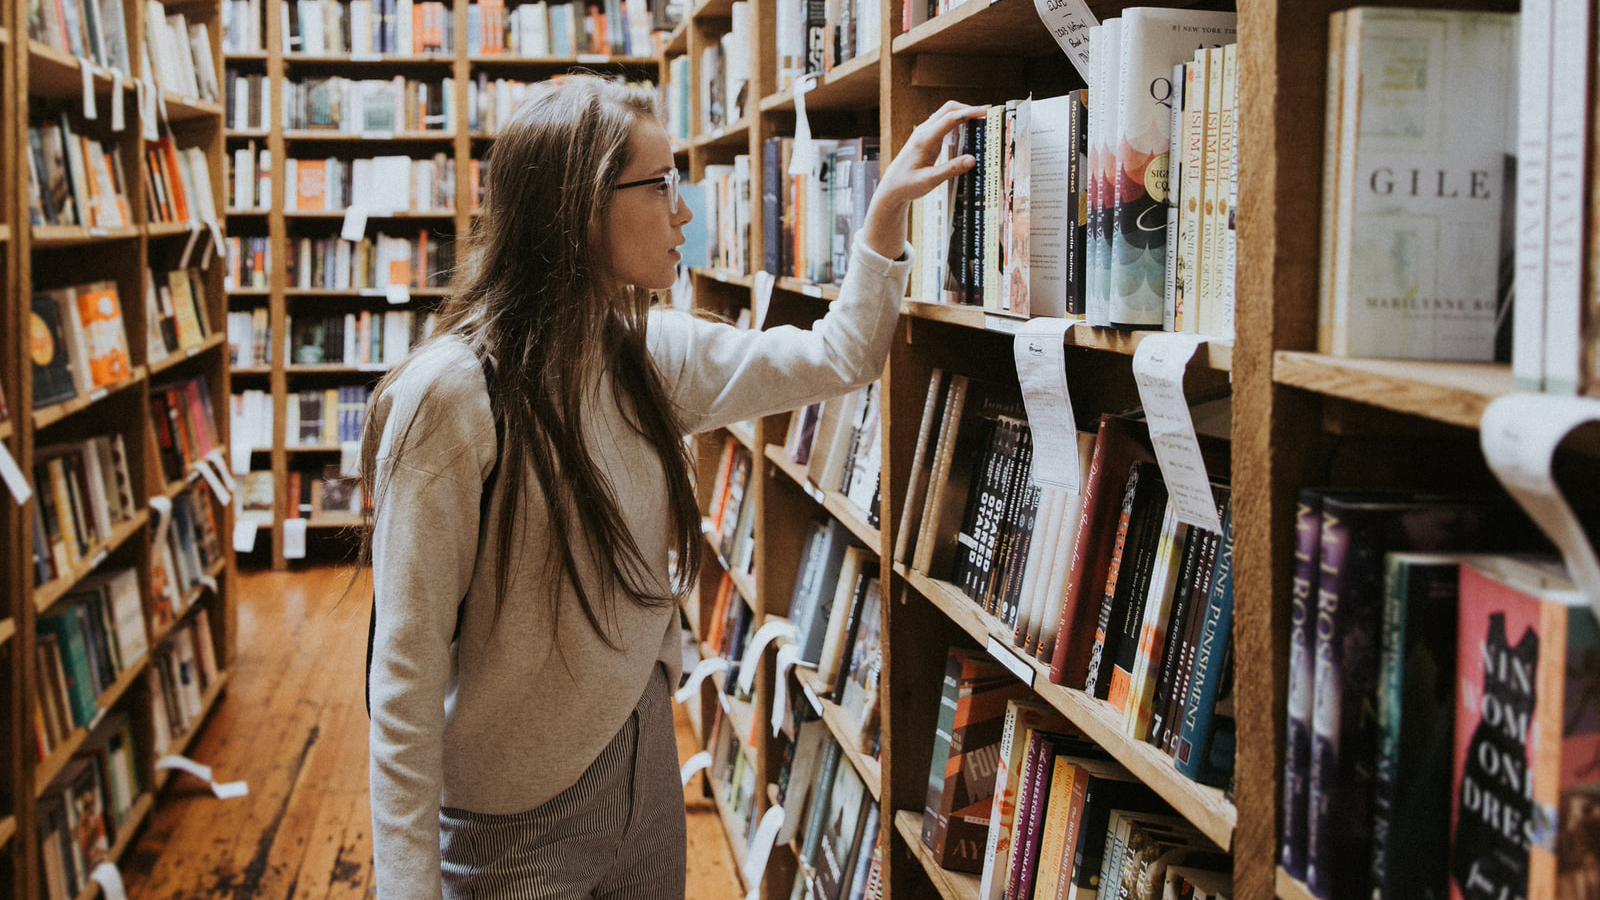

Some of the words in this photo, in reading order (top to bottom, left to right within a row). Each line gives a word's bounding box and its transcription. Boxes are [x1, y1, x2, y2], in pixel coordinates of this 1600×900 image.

[1189, 110, 1201, 183] ISHMAEL
[1205, 110, 1218, 187] ISHMAEL
[1219, 108, 1231, 186] ISHMAEL
[1369, 167, 1492, 199] GILE
[1167, 220, 1175, 247] Anna
[1187, 220, 1195, 257] DANIEL
[1203, 222, 1211, 259] DANIEL
[1166, 250, 1175, 300] Quindlen
[1185, 259, 1193, 295] QUINN
[1201, 261, 1210, 299] QUINN
[1215, 262, 1223, 300] QUINN
[1008, 461, 1022, 522] IMPERFECTIONISTS
[1013, 464, 1027, 525] IMPERFECTIONISTS
[1087, 462, 1099, 495] Devil
[1083, 496, 1091, 509] in
[969, 491, 987, 563] OTARED
[976, 494, 994, 567] OTARED
[983, 498, 1001, 572] OTARED
[1070, 511, 1087, 572] Jerusalem
[1201, 535, 1209, 556] WHY
[1184, 545, 1195, 581] RAKHA
[1209, 539, 1218, 560] WHY
[1193, 566, 1203, 589] CAME
[1202, 570, 1211, 594] CAME
[1123, 601, 1132, 634] Childhood
[1130, 606, 1140, 639] Childhood
[1163, 618, 1181, 684] CROCODILES
[1185, 602, 1219, 733] PUNISHMENT
[1018, 754, 1032, 825] UNRESTORED
[1054, 763, 1062, 789] KNOW
[1063, 774, 1072, 802] KNOW
[1028, 763, 1042, 835] UNRESTORED
[1049, 793, 1057, 817] YOUR
[1059, 805, 1067, 831] YOUR
[1010, 828, 1020, 871] WOMAN
[1043, 819, 1053, 860] BEHOLDER
[1053, 833, 1062, 874] BEHOLDER
[1062, 844, 1070, 870] RASH
[1020, 839, 1030, 882] WOMAN
[1124, 847, 1135, 878] THE
[1137, 859, 1147, 890] THE
